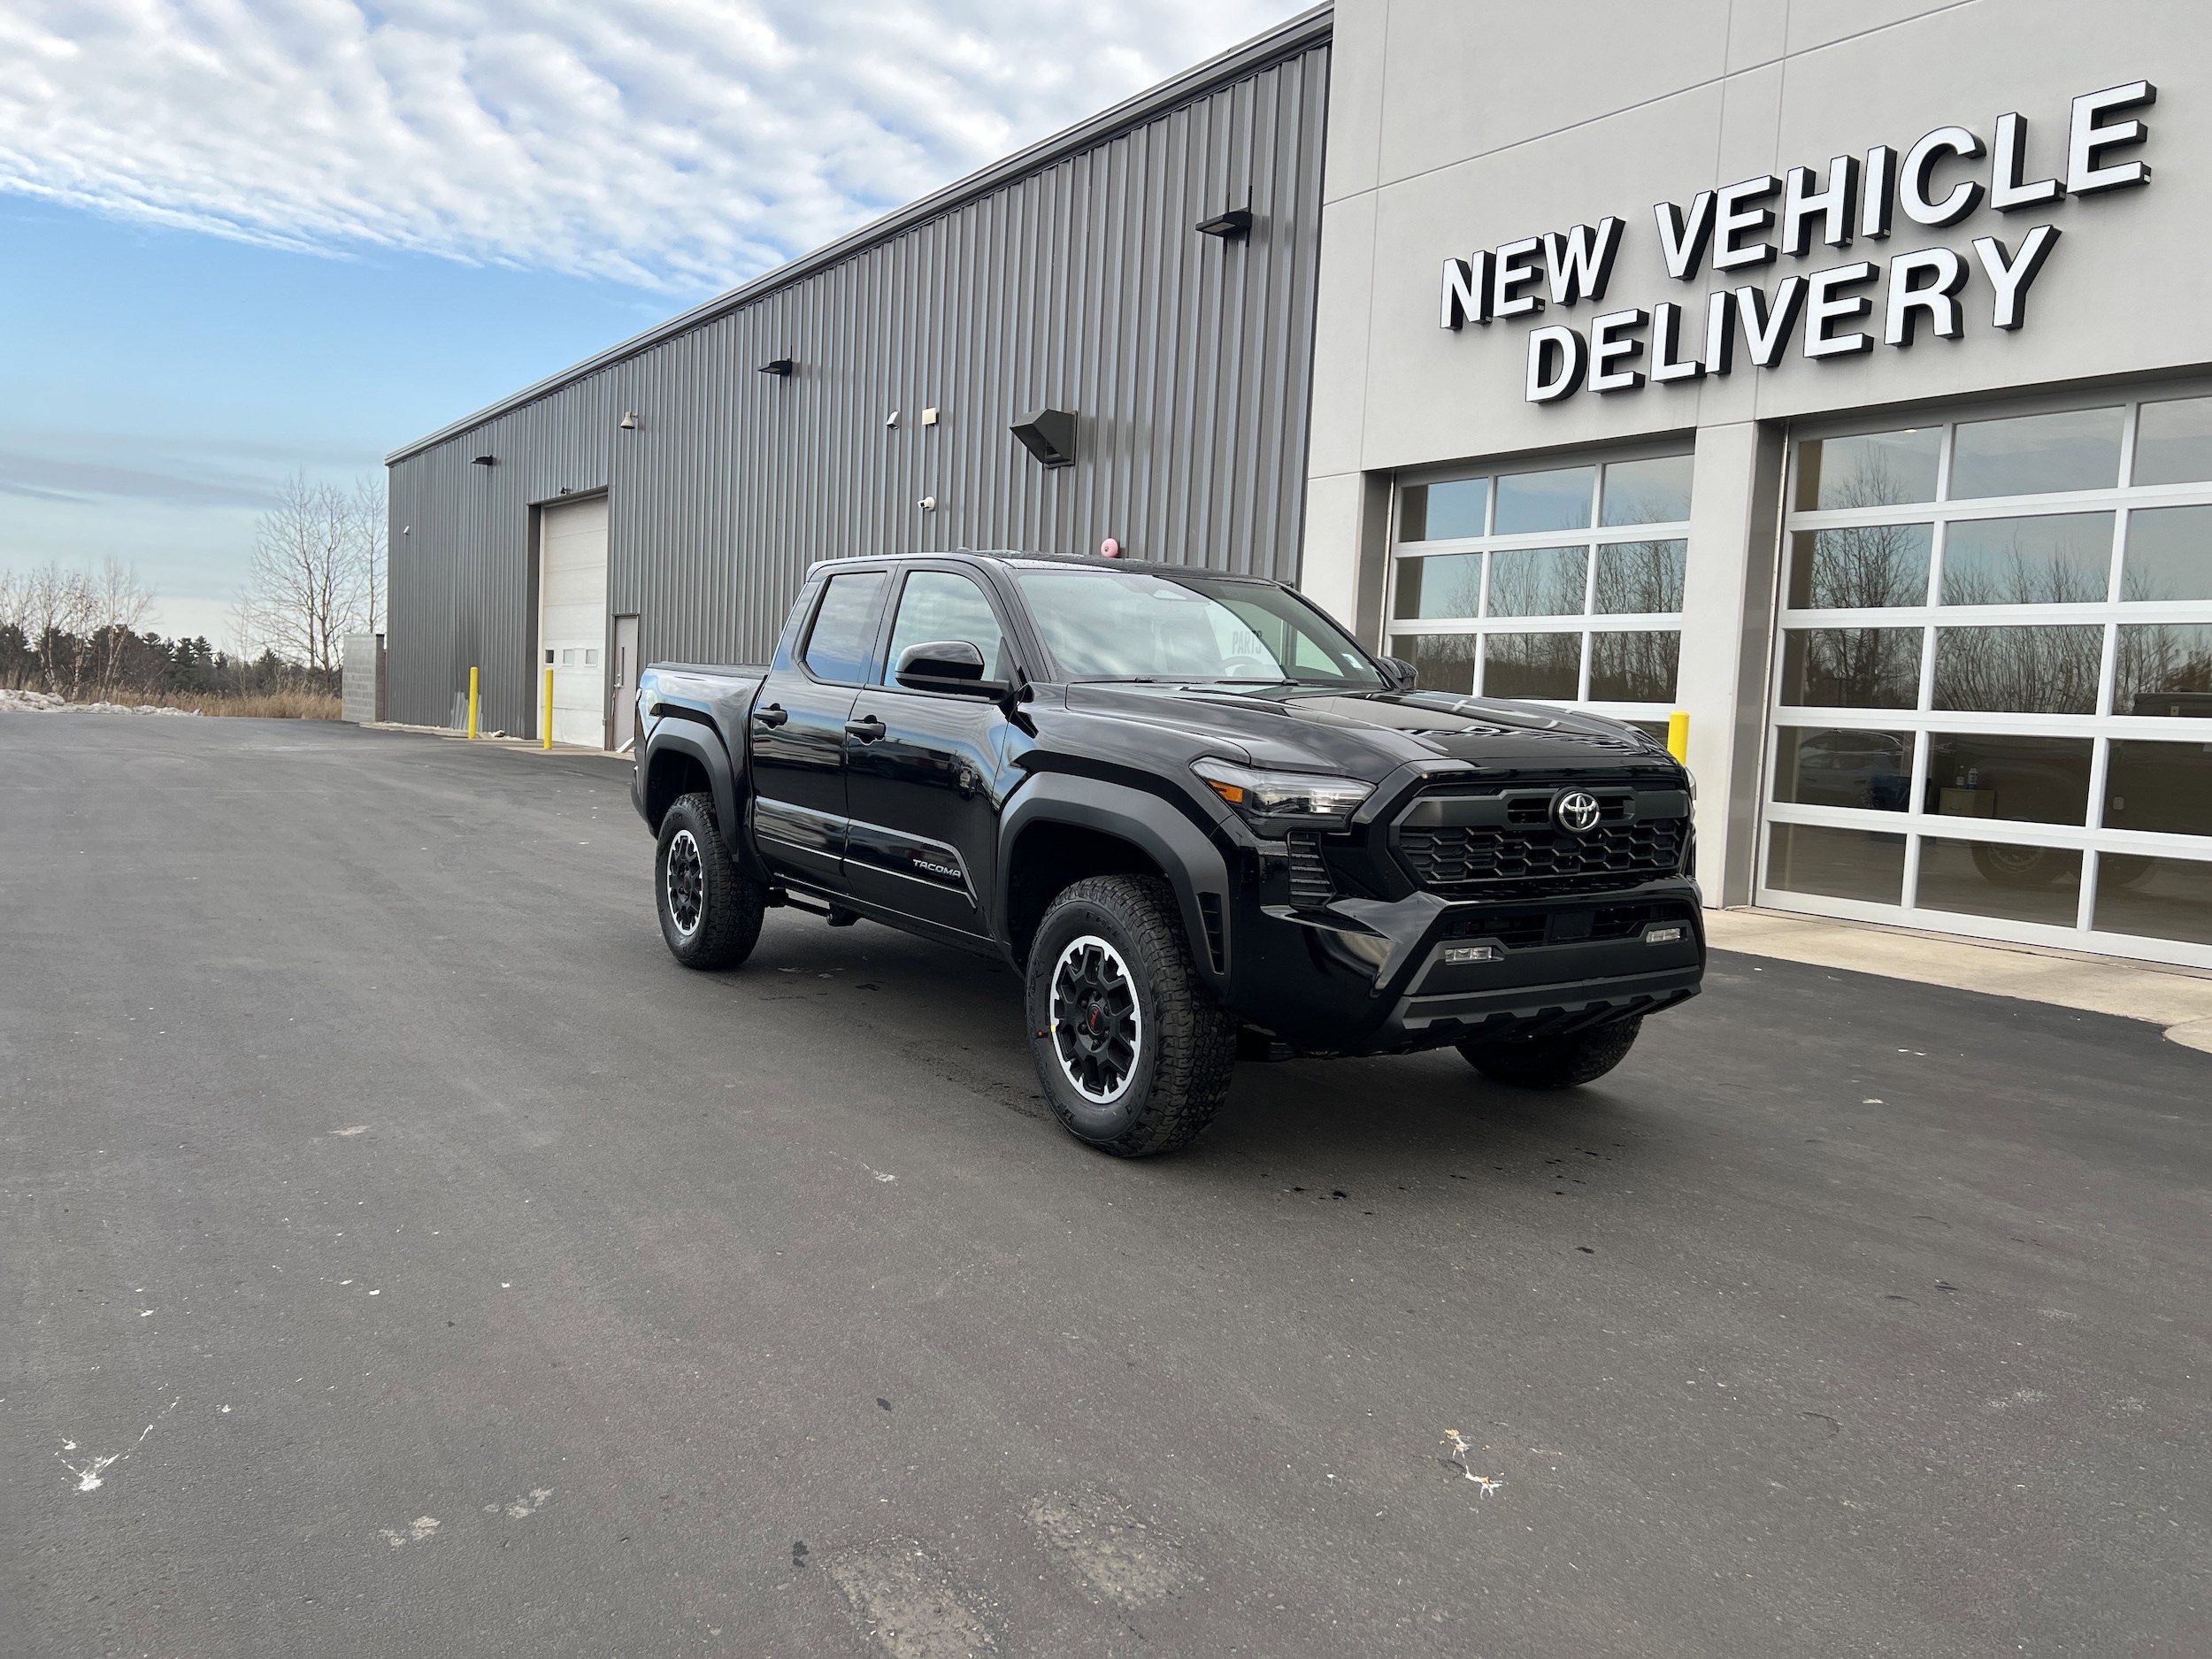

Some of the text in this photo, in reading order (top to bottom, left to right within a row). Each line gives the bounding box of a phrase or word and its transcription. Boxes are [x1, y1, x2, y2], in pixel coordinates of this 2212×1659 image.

[1440, 80, 2157, 330] NEW VEHICLE
[1525, 224, 2062, 403] DELIVERY
[1233, 630, 1263, 654] PARTS
[912, 858, 962, 878] TACOMA
